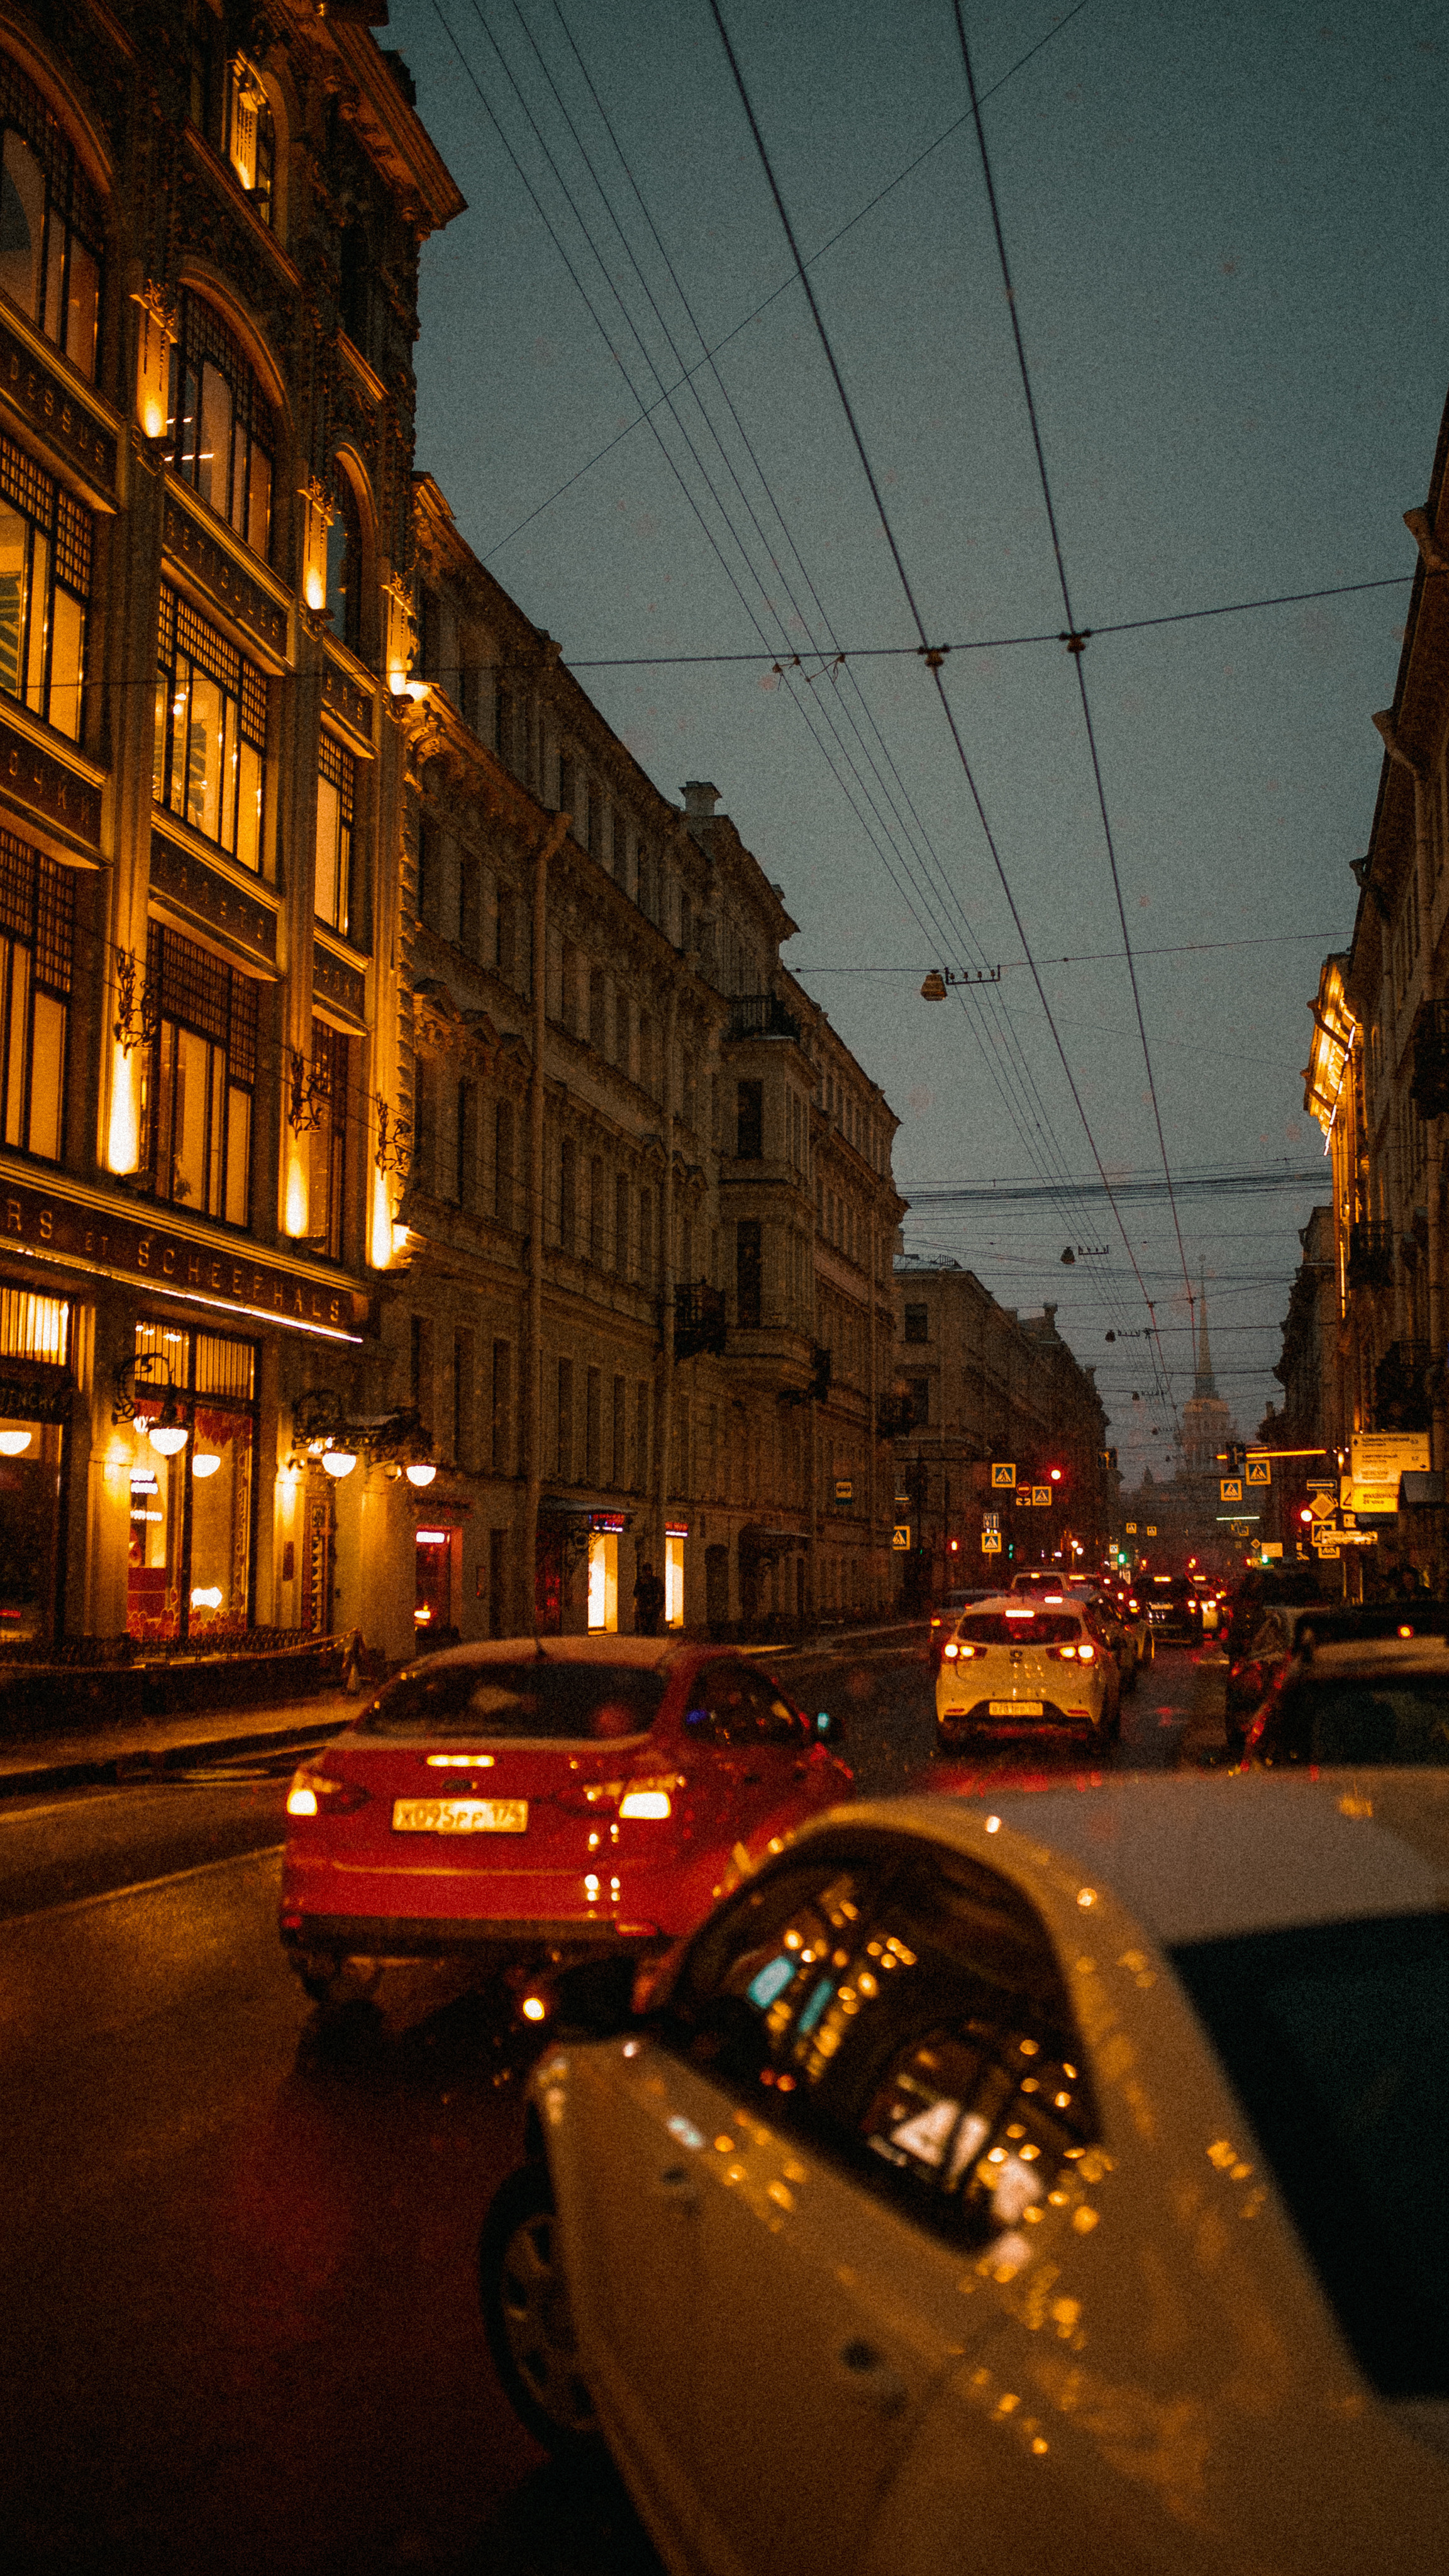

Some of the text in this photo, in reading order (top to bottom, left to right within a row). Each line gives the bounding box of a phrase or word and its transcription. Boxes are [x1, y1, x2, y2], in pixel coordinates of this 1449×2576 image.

[6, 1198, 340, 1323] RS ET SCHEEFHALS
